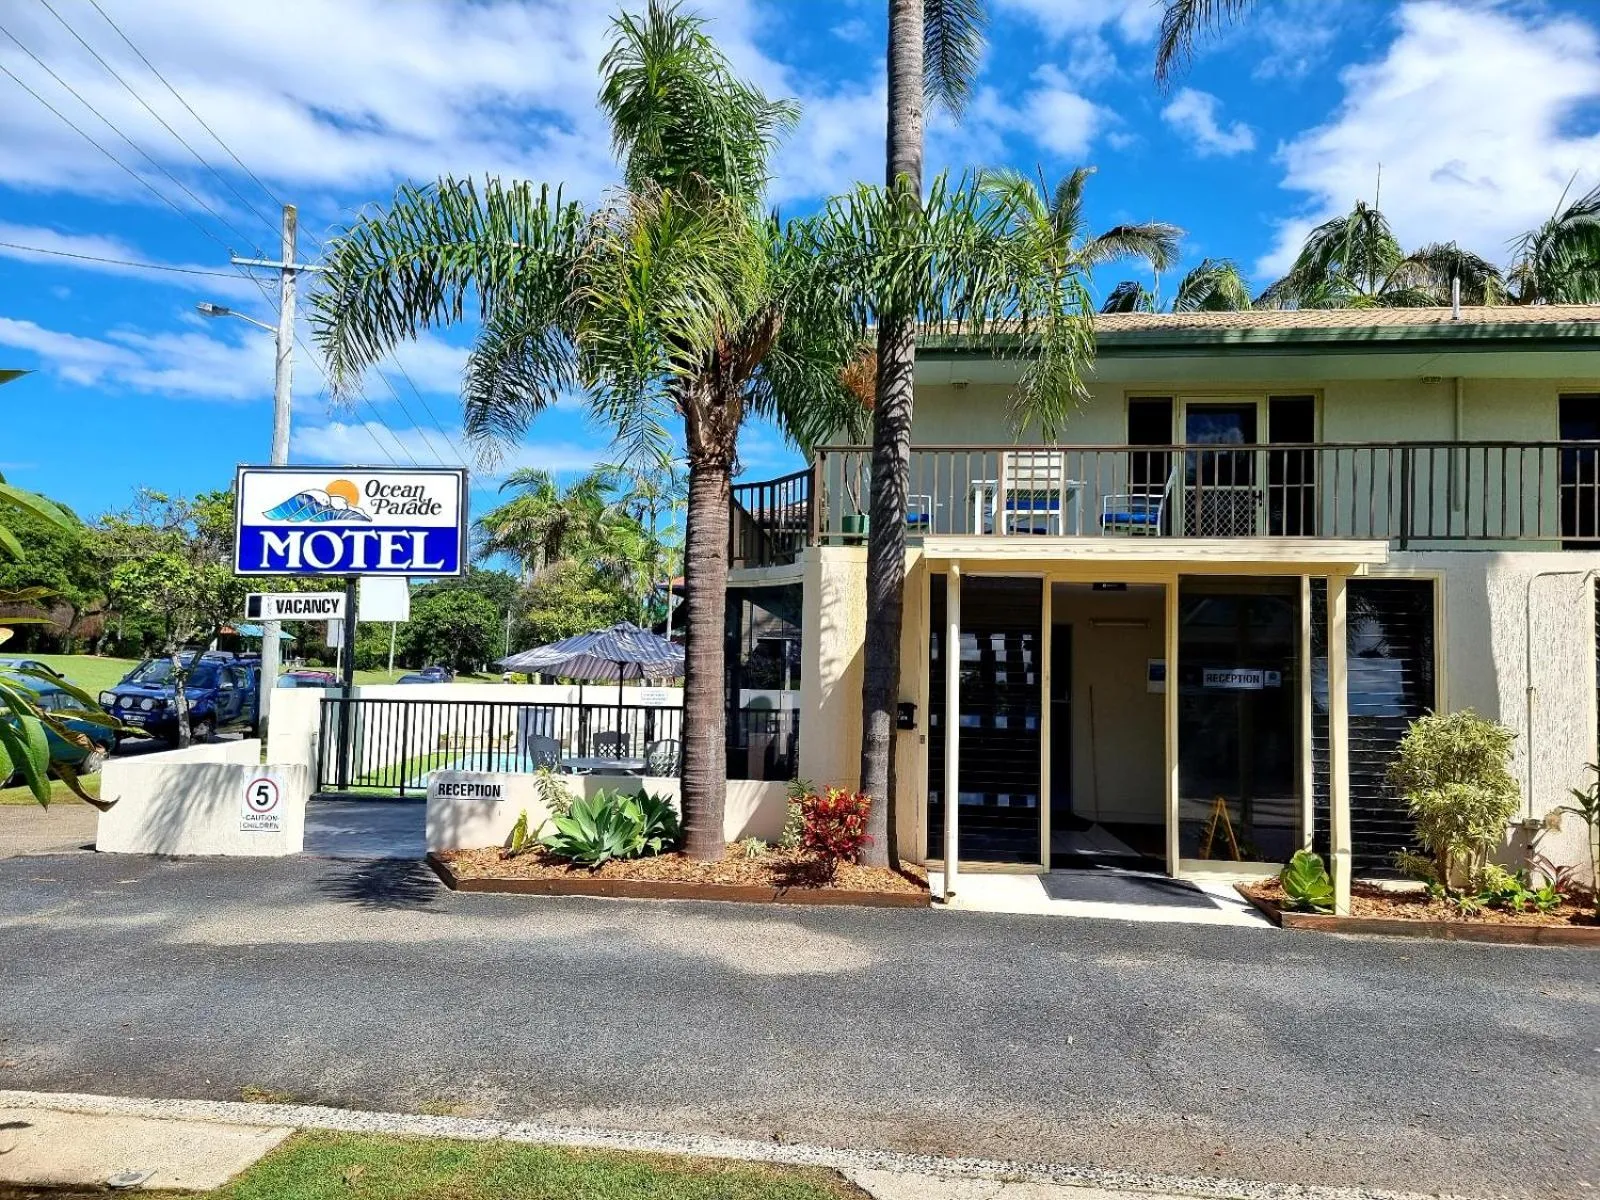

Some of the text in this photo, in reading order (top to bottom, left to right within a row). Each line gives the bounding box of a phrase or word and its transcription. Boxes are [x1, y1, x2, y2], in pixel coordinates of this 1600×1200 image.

[365, 479, 425, 501] Ocean
[370, 498, 442, 516] Parade
[259, 529, 445, 570] MOTEL
[276, 598, 340, 614] VACANCY
[1206, 673, 1260, 684] RECEPTION
[255, 785, 269, 806] 5
[438, 783, 501, 798] RECEPTION
